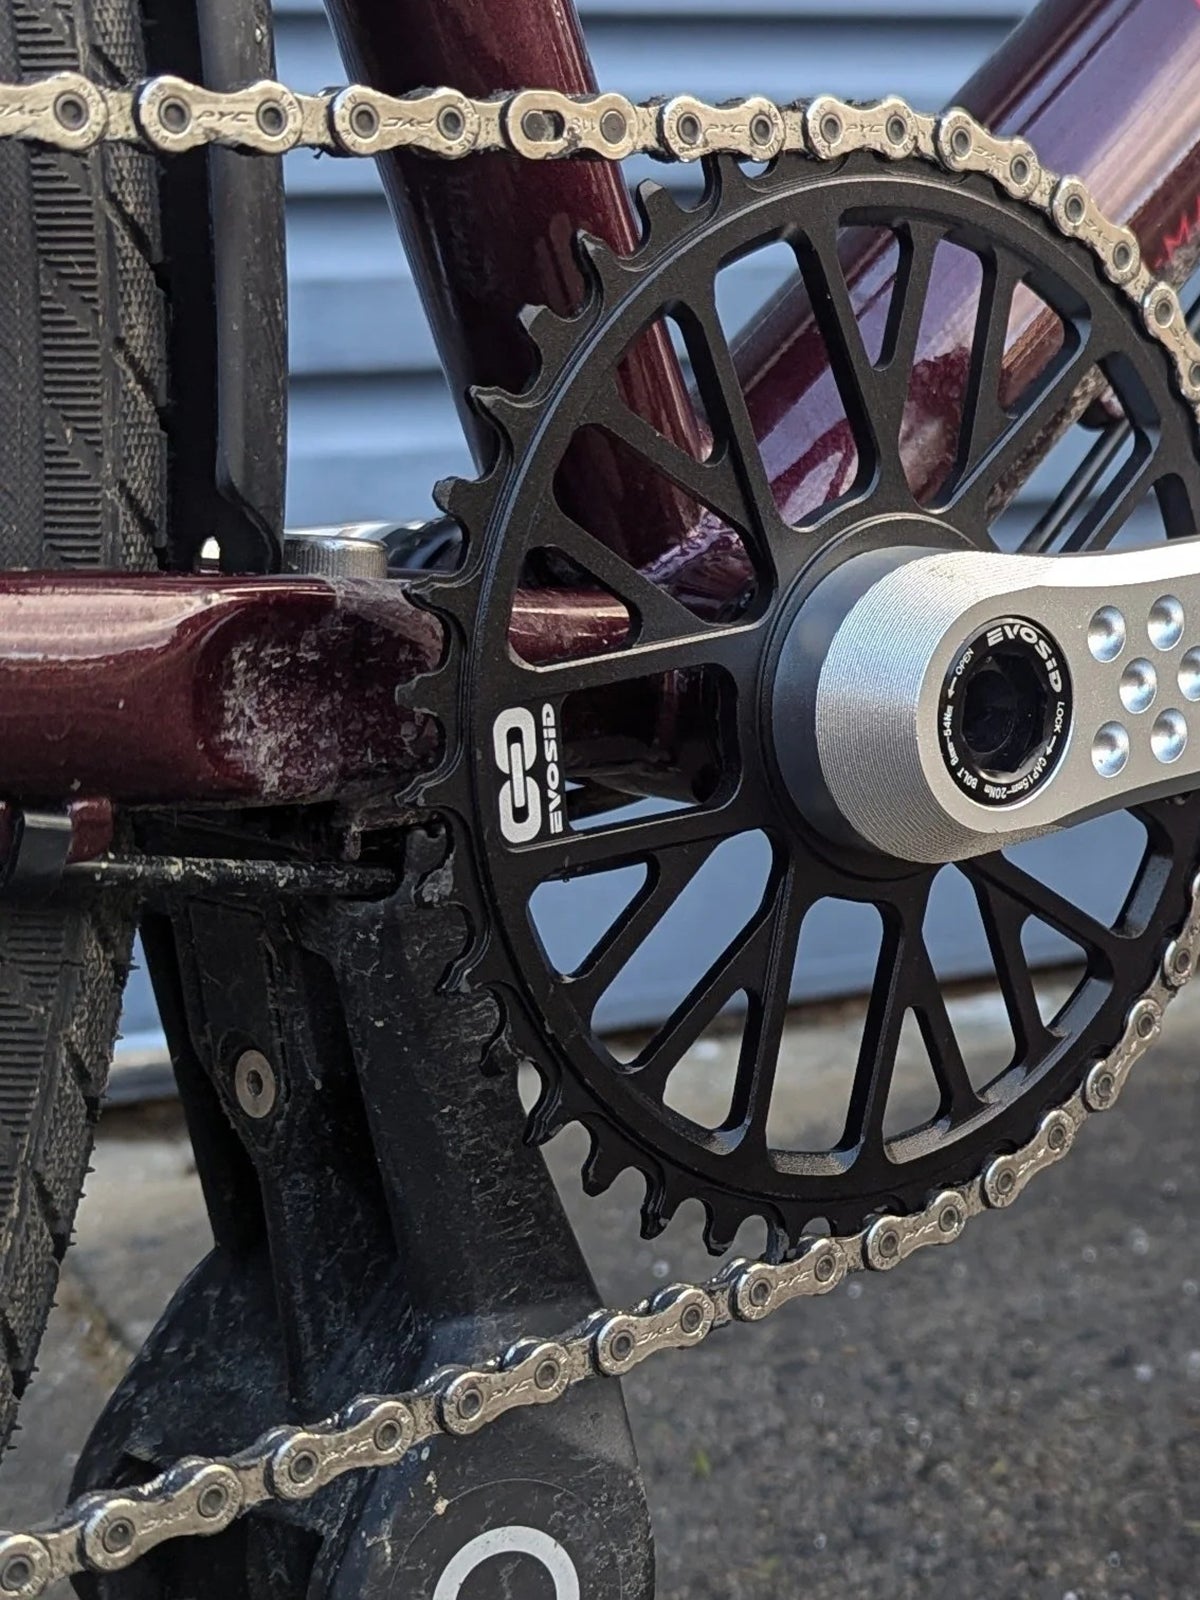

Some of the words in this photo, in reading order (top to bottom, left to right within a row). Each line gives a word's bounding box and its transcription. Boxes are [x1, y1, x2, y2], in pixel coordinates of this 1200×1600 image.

[955, 648, 975, 676] OPEN
[1053, 701, 1066, 733] LOCK
[956, 766, 979, 790] BOLT
